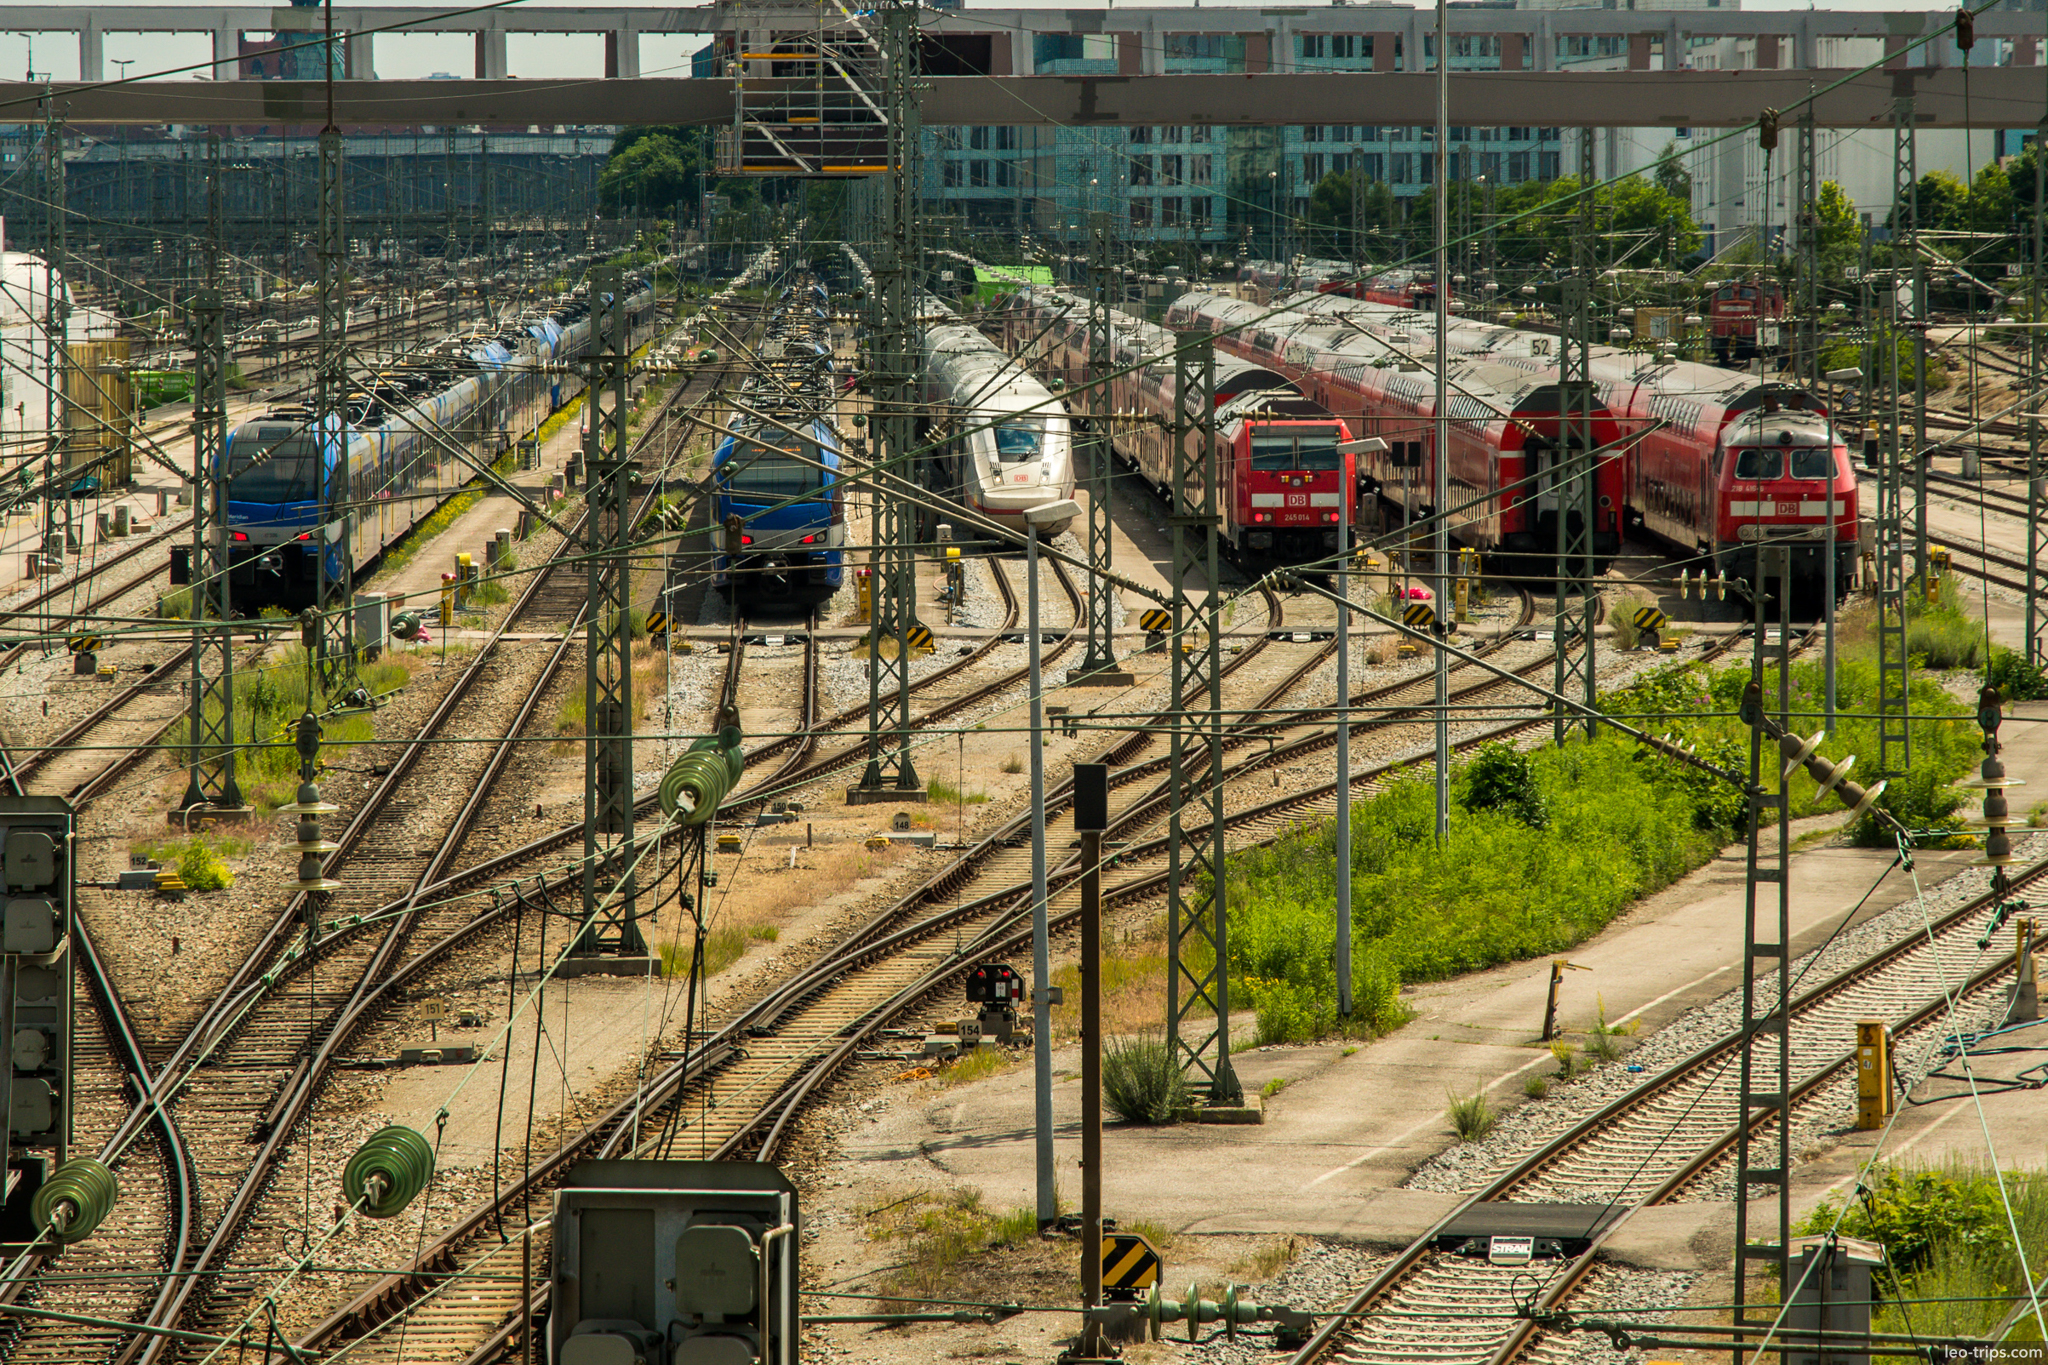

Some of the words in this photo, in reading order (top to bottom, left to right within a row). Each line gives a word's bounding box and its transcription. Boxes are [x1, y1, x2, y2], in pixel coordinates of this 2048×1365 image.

[1665, 272, 1678, 282] 50
[520, 339, 538, 355] 56
[1532, 339, 1549, 355] 52
[1014, 474, 1028, 482] DB
[1289, 495, 1306, 506] DB
[1779, 503, 1796, 514] DB
[1284, 513, 1297, 521] 245
[1298, 513, 1310, 521] 014
[772, 802, 787, 811] 150
[894, 821, 909, 830] 148
[131, 856, 147, 866] 152
[425, 1003, 440, 1015] 151
[961, 1025, 980, 1036] 154
[1492, 1244, 1530, 1253] STRAIL
